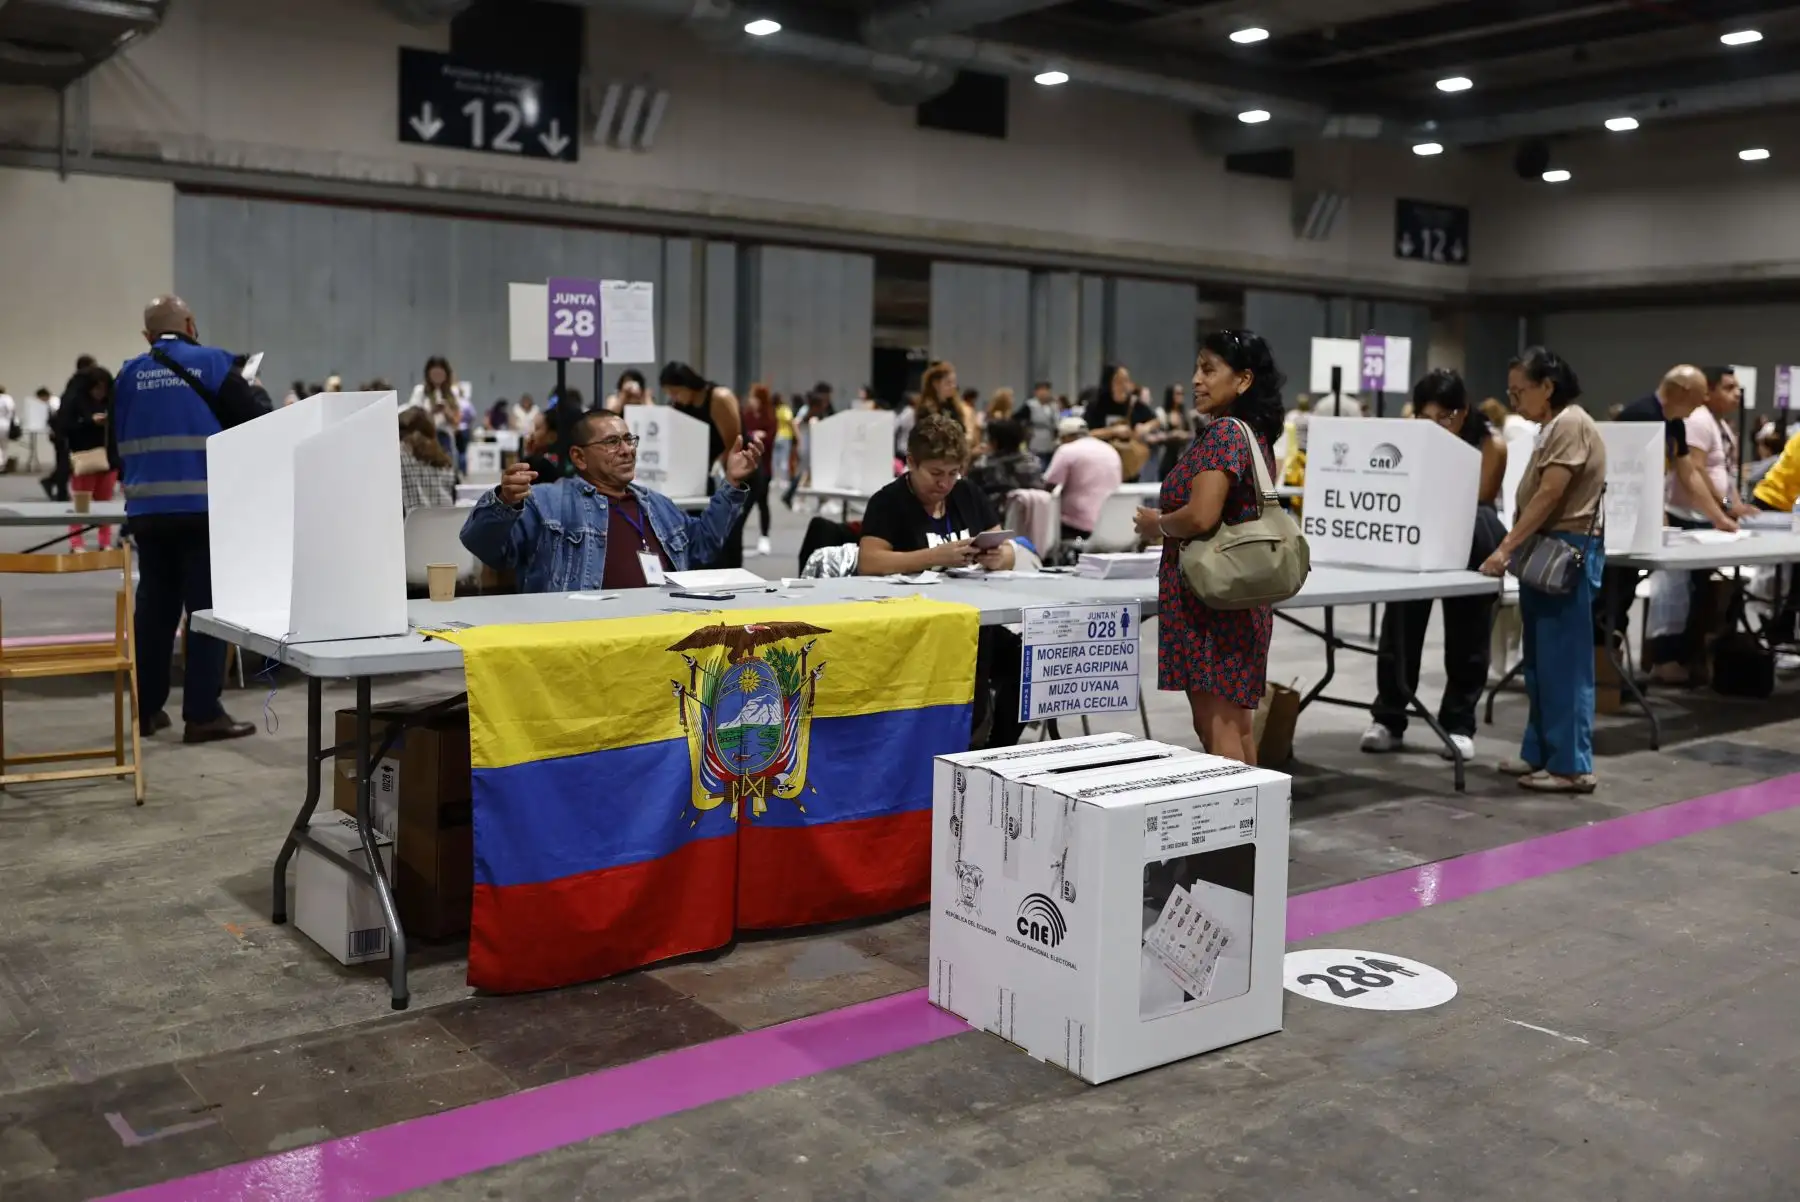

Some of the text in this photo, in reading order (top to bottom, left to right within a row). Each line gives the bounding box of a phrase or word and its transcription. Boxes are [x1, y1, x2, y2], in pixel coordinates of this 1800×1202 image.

[461, 98, 523, 150] 12
[1421, 228, 1447, 260] 12
[552, 293, 596, 305] JUNTA
[553, 309, 595, 337] 28
[137, 377, 190, 390] ELECTORA
[1324, 489, 1401, 513] EL VOTO
[1304, 517, 1421, 545] ES SECRETO
[1087, 611, 1109, 620] JUNTA
[1088, 621, 1116, 638] 028
[1037, 642, 1134, 660] MOREIRA CEDEÑO
[1043, 660, 1129, 677] NIEVE AGRIPINA
[1049, 680, 1119, 696] MUZO UYANA
[1038, 696, 1128, 714] MARTHA CECILIA
[968, 919, 976, 928] DEL
[976, 922, 997, 937] ECUADOR
[1017, 916, 1049, 945] CNE
[1005, 935, 1078, 971] CONSEJO NACIONAL ELECTORAL
[1297, 965, 1394, 999] 28
